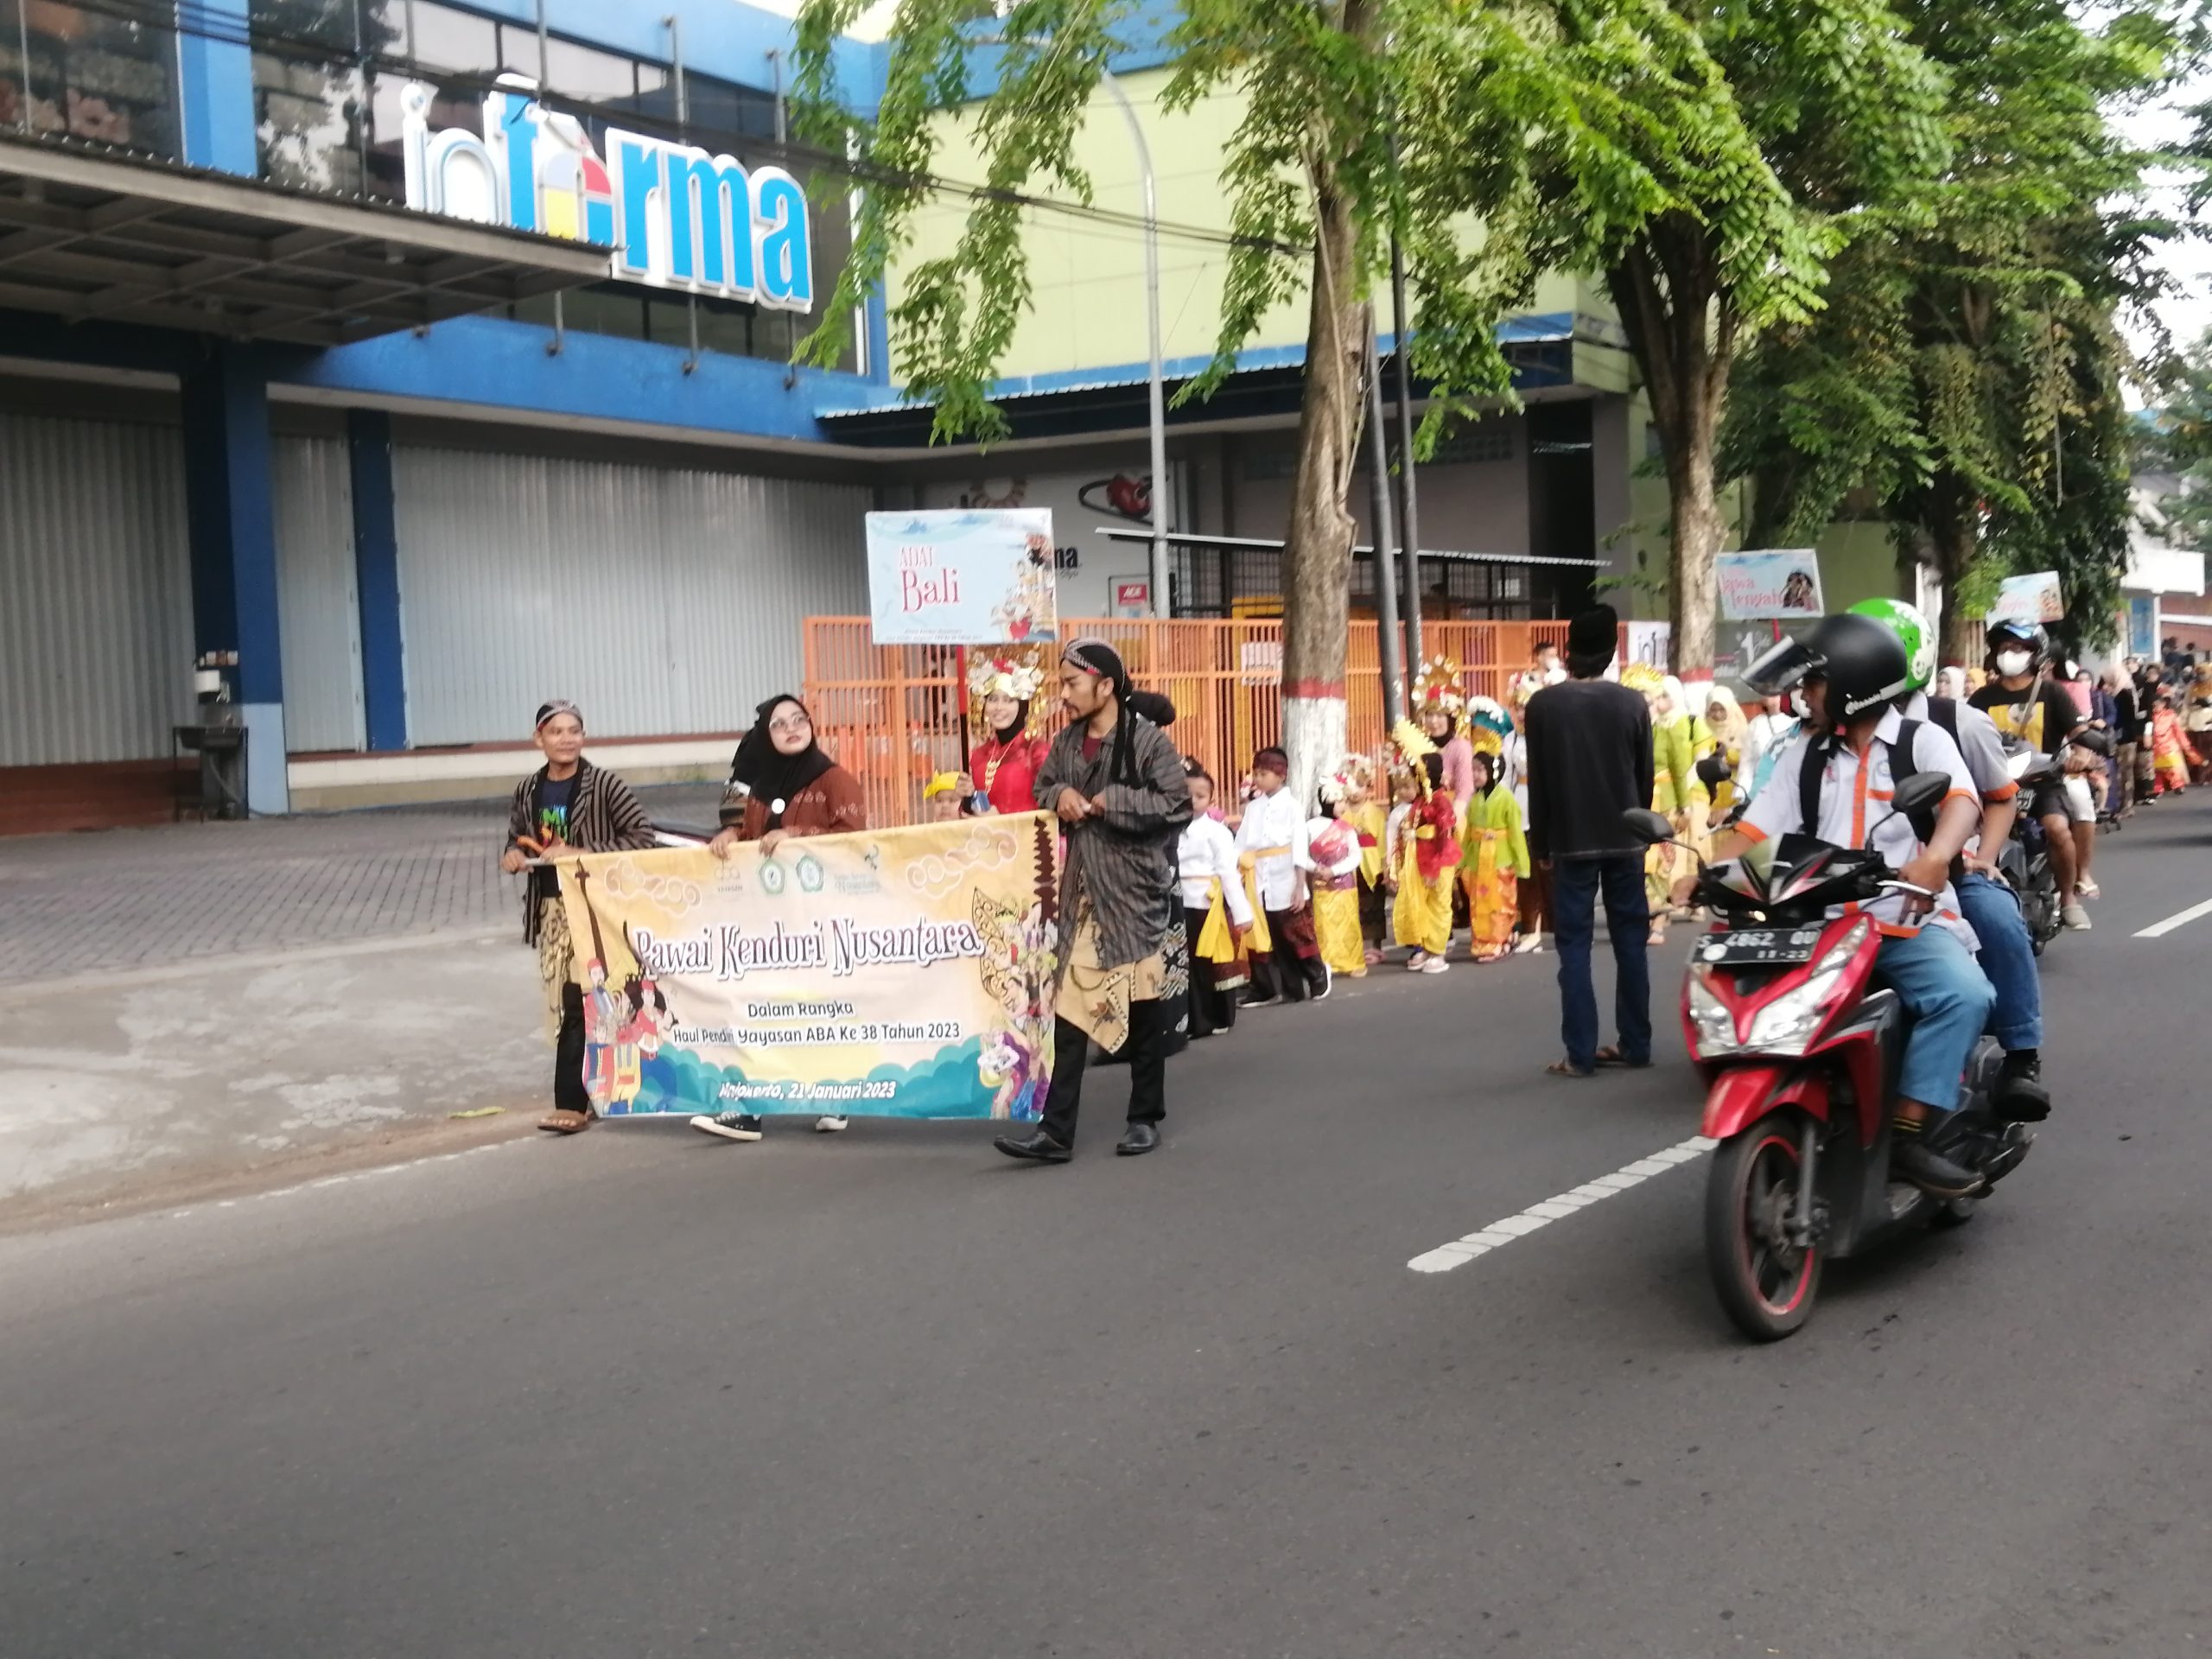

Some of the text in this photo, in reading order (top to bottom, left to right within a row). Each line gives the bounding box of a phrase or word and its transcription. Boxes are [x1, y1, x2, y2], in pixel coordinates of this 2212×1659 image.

[901, 567, 959, 613] Bali
[635, 916, 981, 978] Pawai Kenduri Nusantara
[747, 1000, 854, 1018] Dalam Rangka
[673, 1027, 699, 1043] Haul
[806, 1027, 836, 1042] ABA
[840, 1026, 857, 1040] Ke
[861, 1025, 878, 1040] 38
[881, 1022, 925, 1039] Tahun
[928, 1022, 960, 1038] 2023
[788, 1083, 804, 1098] 21
[807, 1082, 862, 1098] Januari
[863, 1081, 897, 1098] 2023
